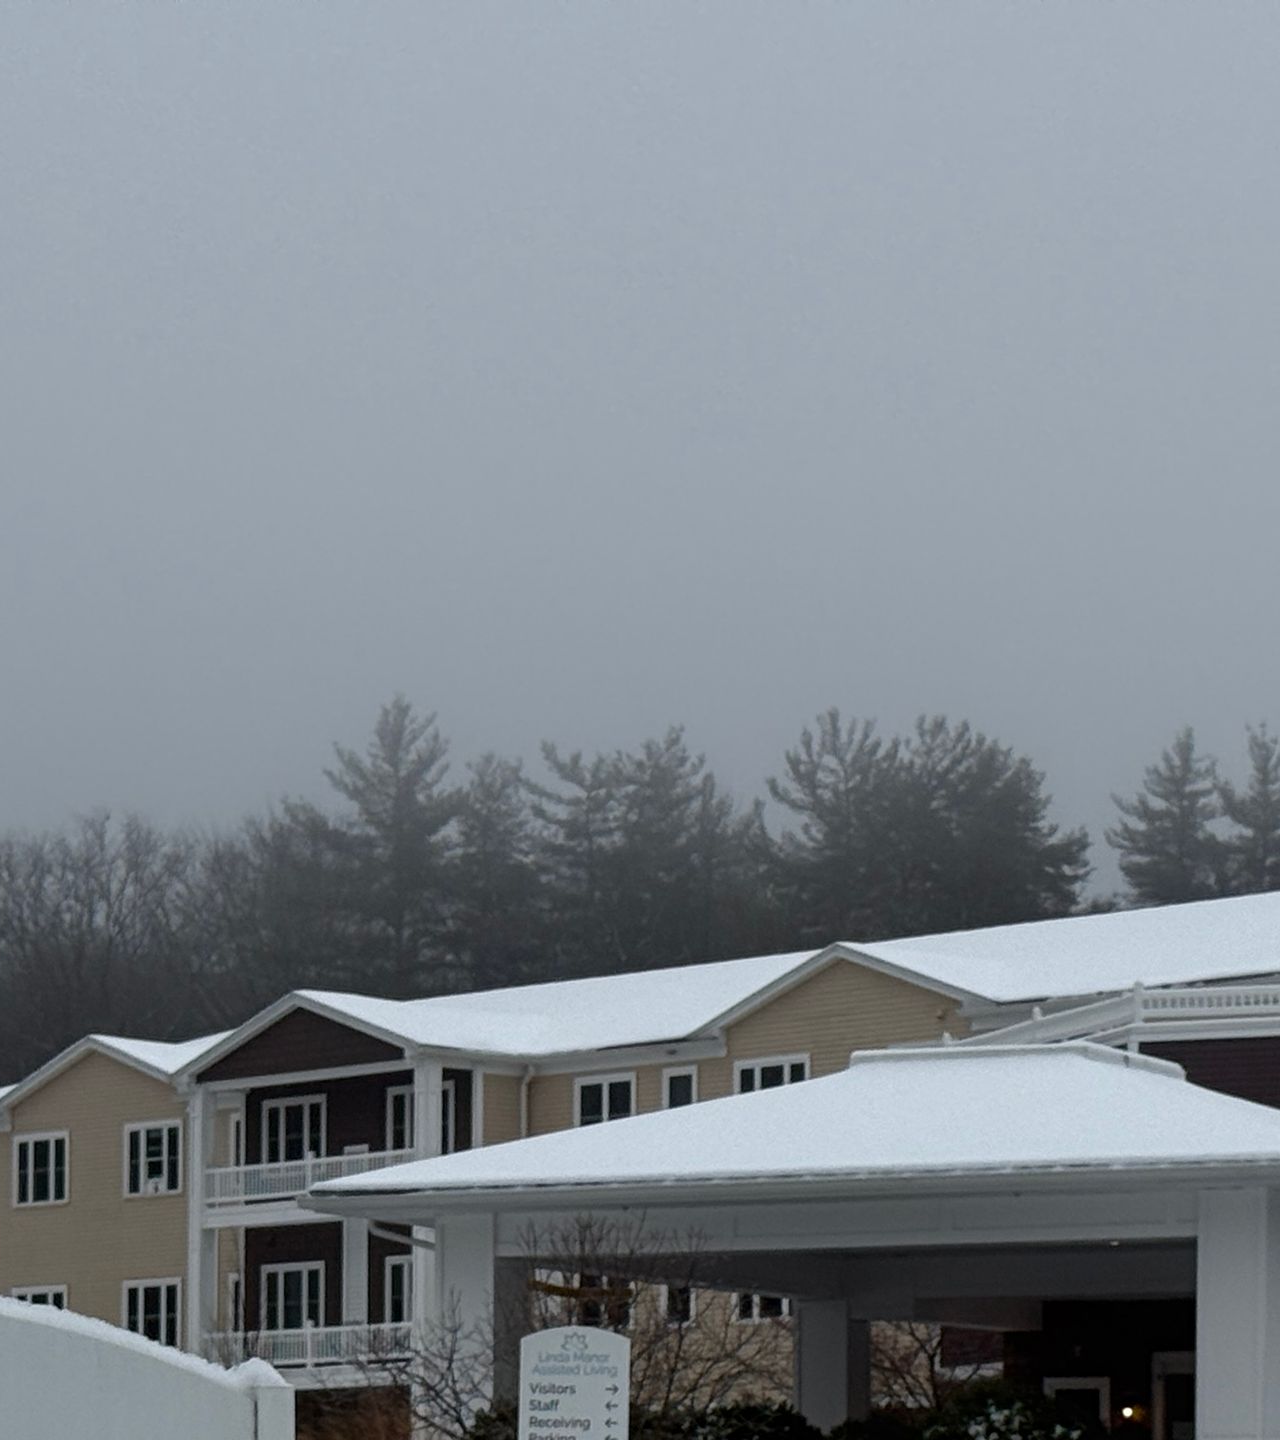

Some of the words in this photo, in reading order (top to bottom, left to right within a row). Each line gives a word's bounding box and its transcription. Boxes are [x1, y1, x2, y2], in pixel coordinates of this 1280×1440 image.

[529, 1382, 576, 1395] Visitors
[529, 1399, 559, 1411] Staff
[528, 1416, 591, 1431] Receiving
